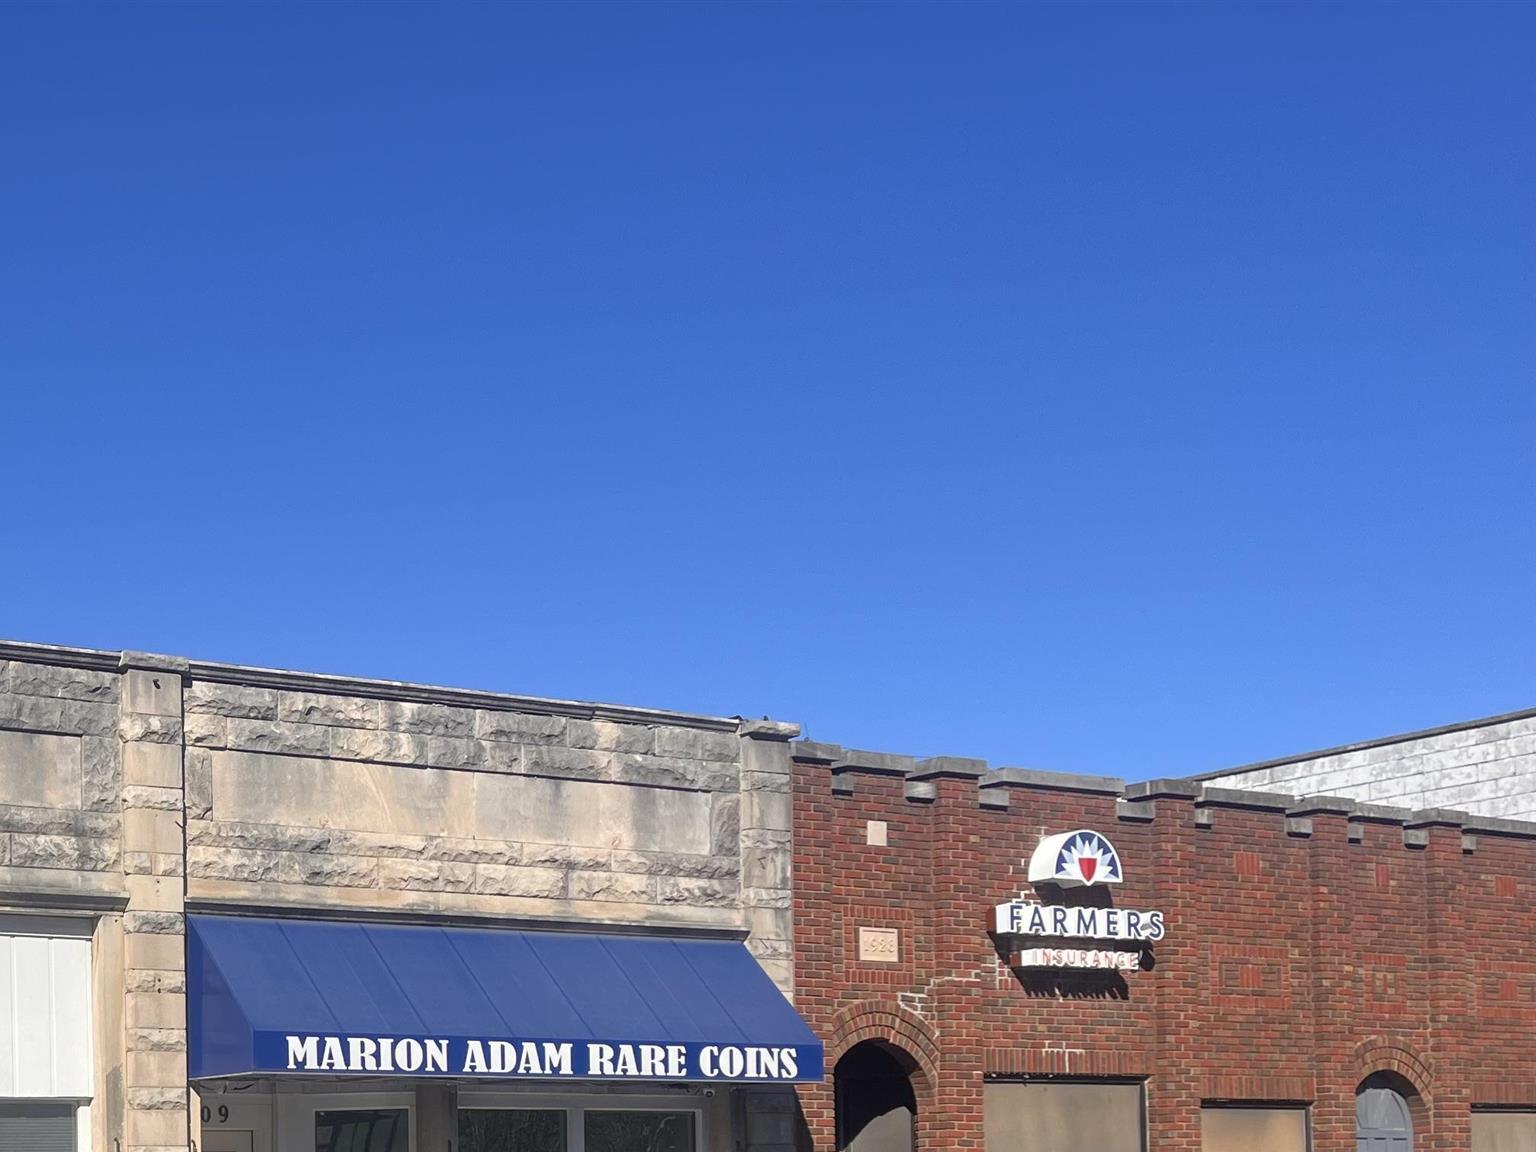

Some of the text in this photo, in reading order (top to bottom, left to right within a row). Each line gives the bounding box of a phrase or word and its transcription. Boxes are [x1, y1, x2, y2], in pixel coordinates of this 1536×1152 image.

[1009, 904, 1163, 938] FARMERS
[1032, 950, 1139, 970] INSURANCE
[286, 1036, 798, 1078] MARION ADAM RARE COINS
[202, 1105, 229, 1123] 09
